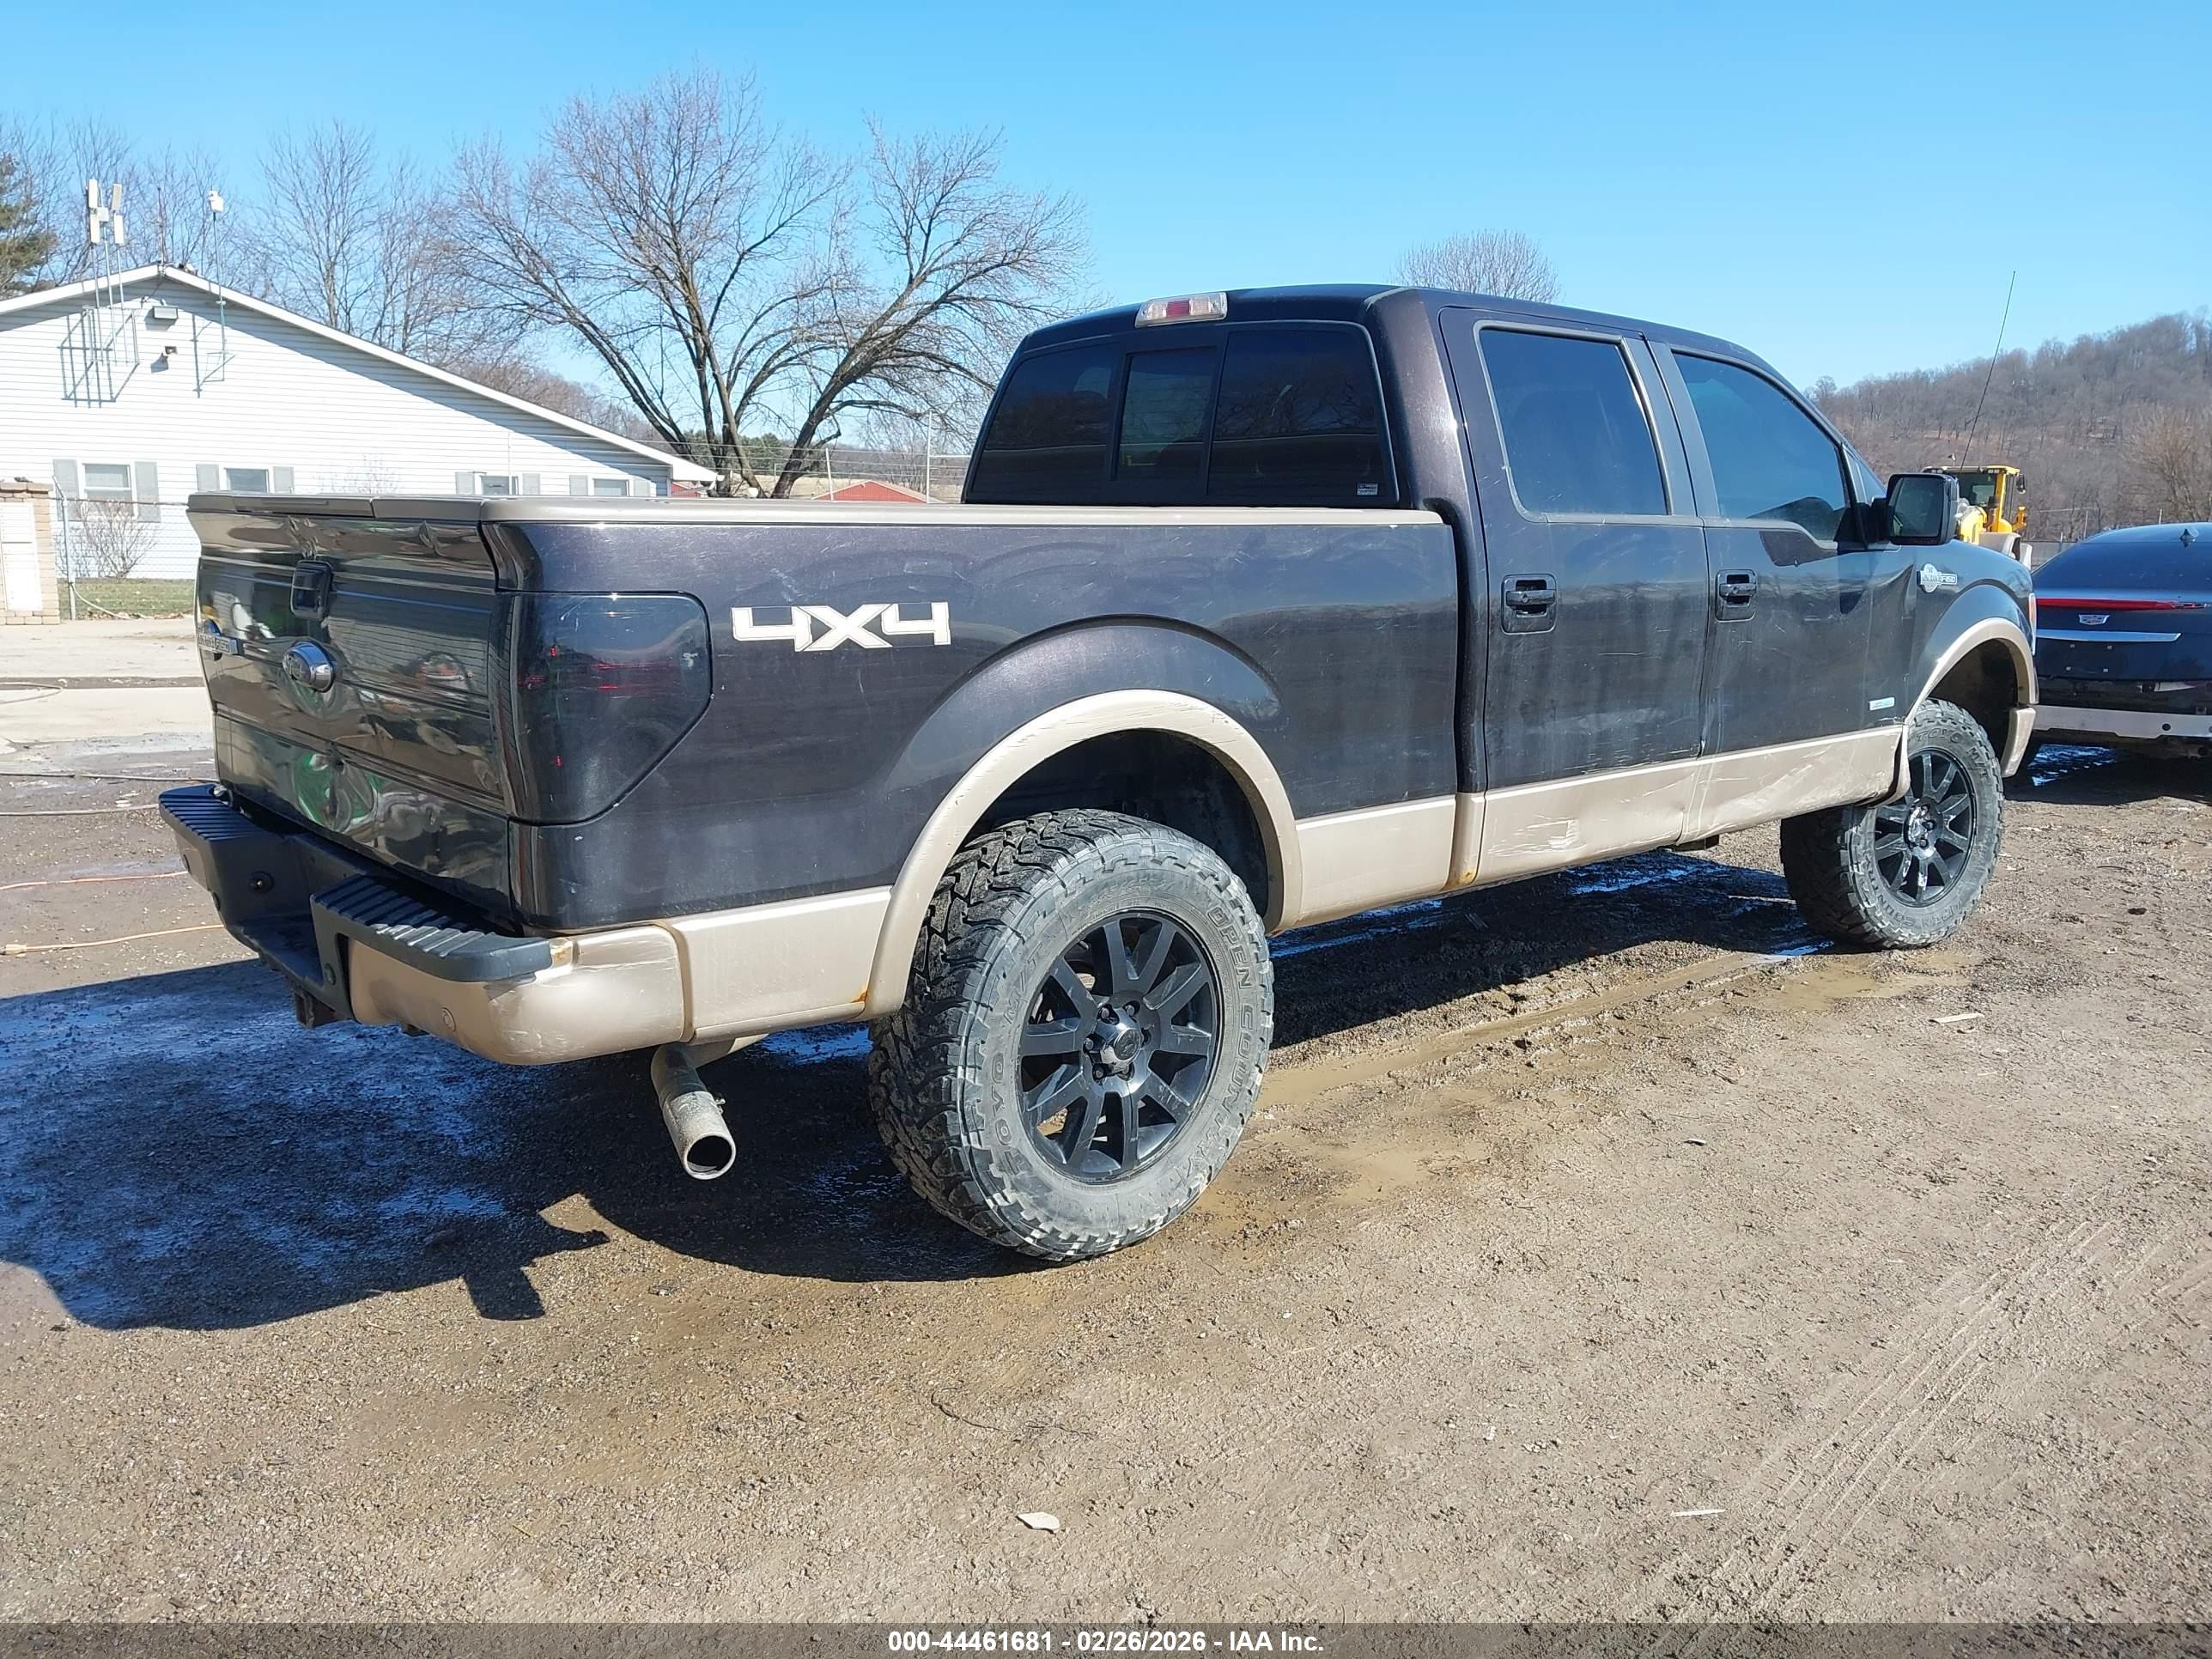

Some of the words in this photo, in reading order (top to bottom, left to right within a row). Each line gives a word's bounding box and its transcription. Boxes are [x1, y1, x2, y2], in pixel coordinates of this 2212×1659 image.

[731, 601, 951, 653] 4X4
[1206, 905, 1254, 990] OPEN
[991, 1053, 1025, 1175] TOYO
